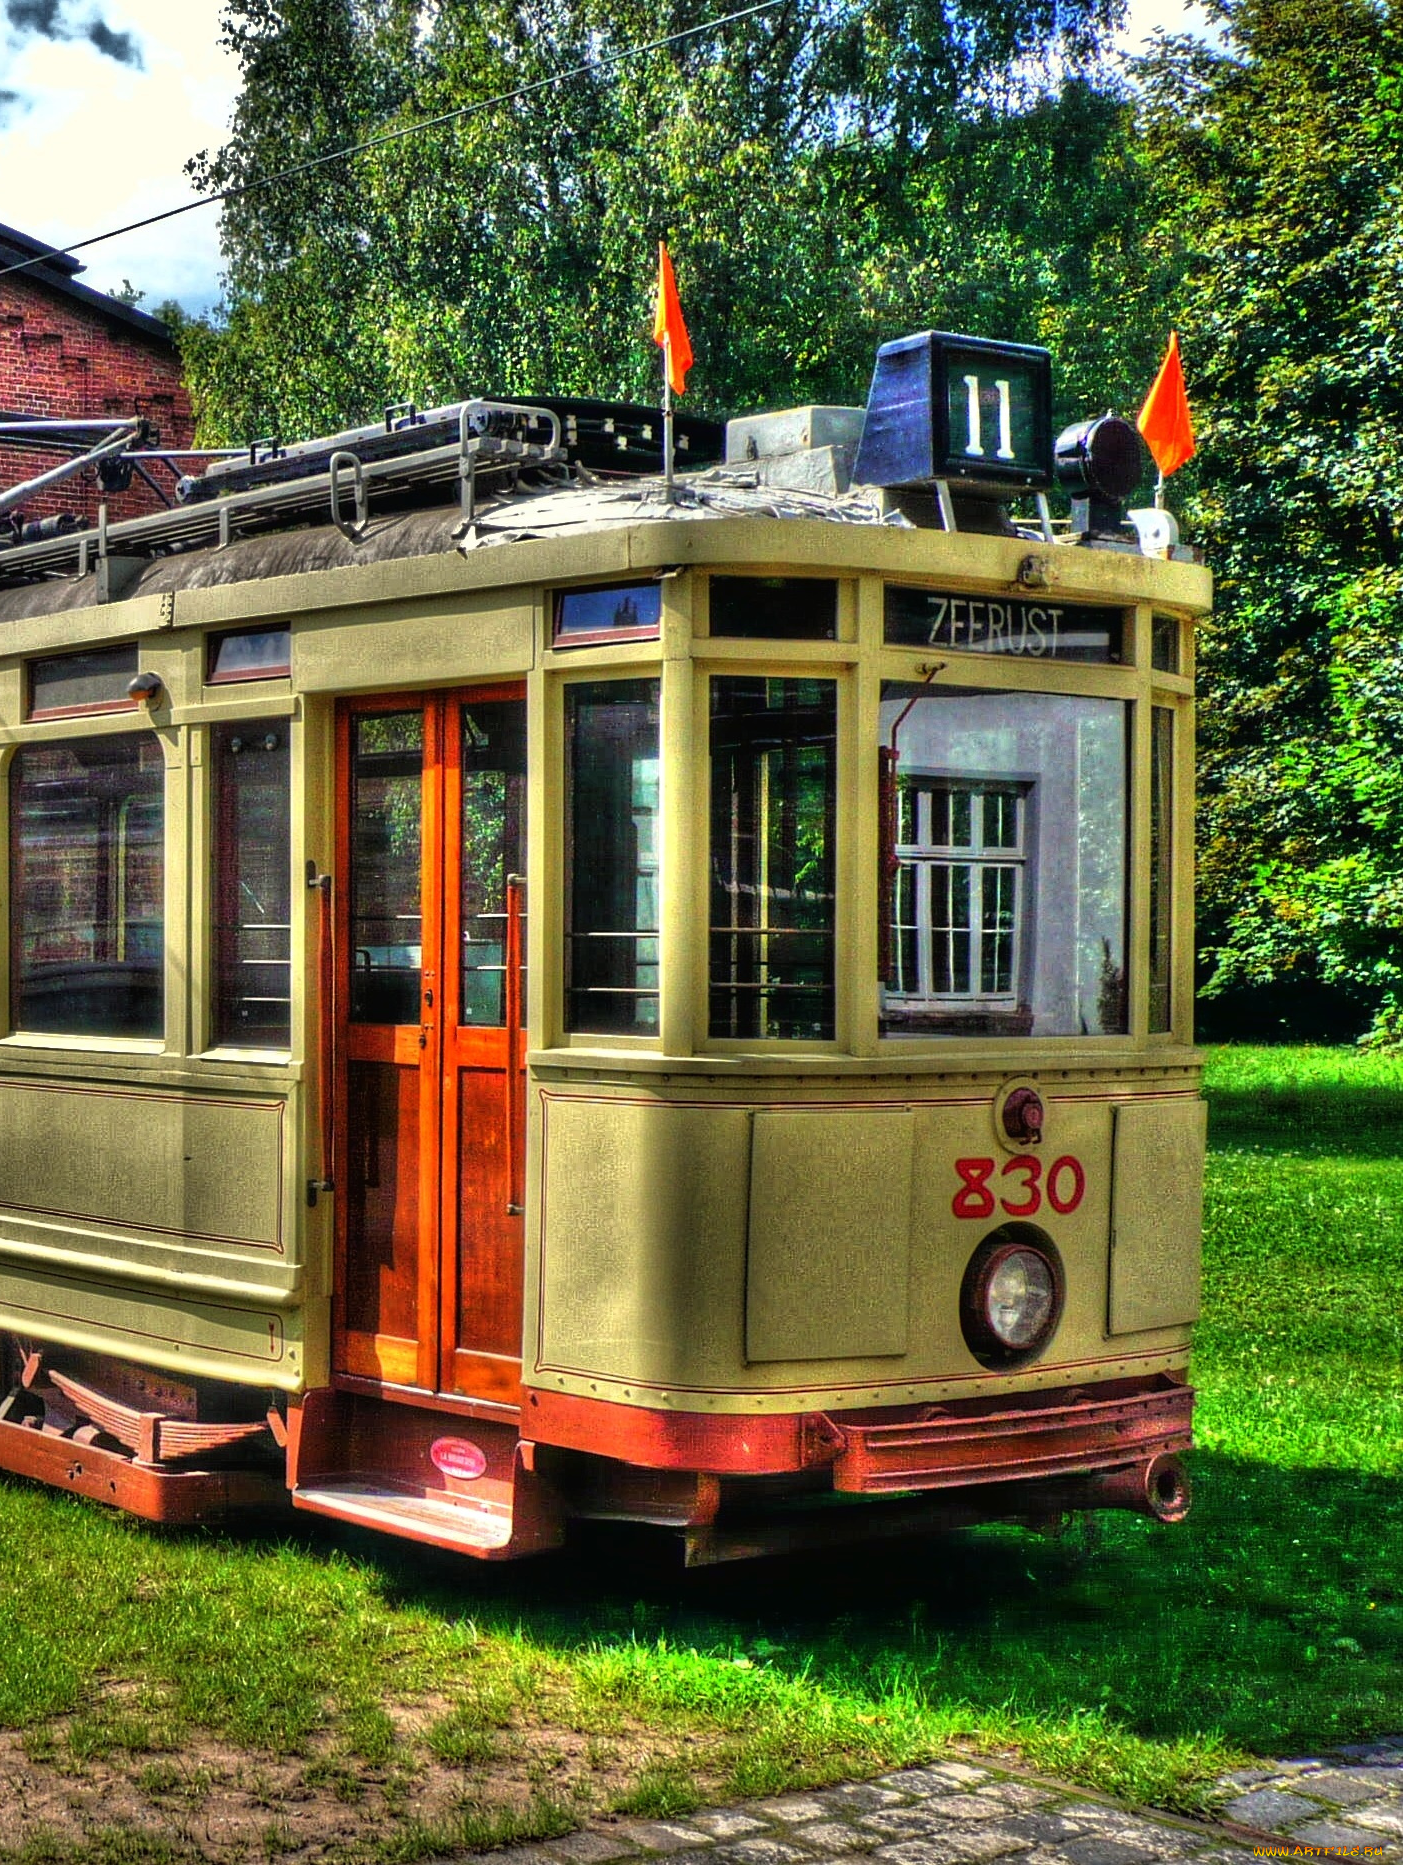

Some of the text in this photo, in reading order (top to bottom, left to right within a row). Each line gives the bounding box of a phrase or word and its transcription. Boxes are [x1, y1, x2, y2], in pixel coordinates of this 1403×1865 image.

[963, 375, 1015, 460] 11
[927, 596, 1064, 658] ZEERUST
[951, 1154, 1086, 1219] 830
